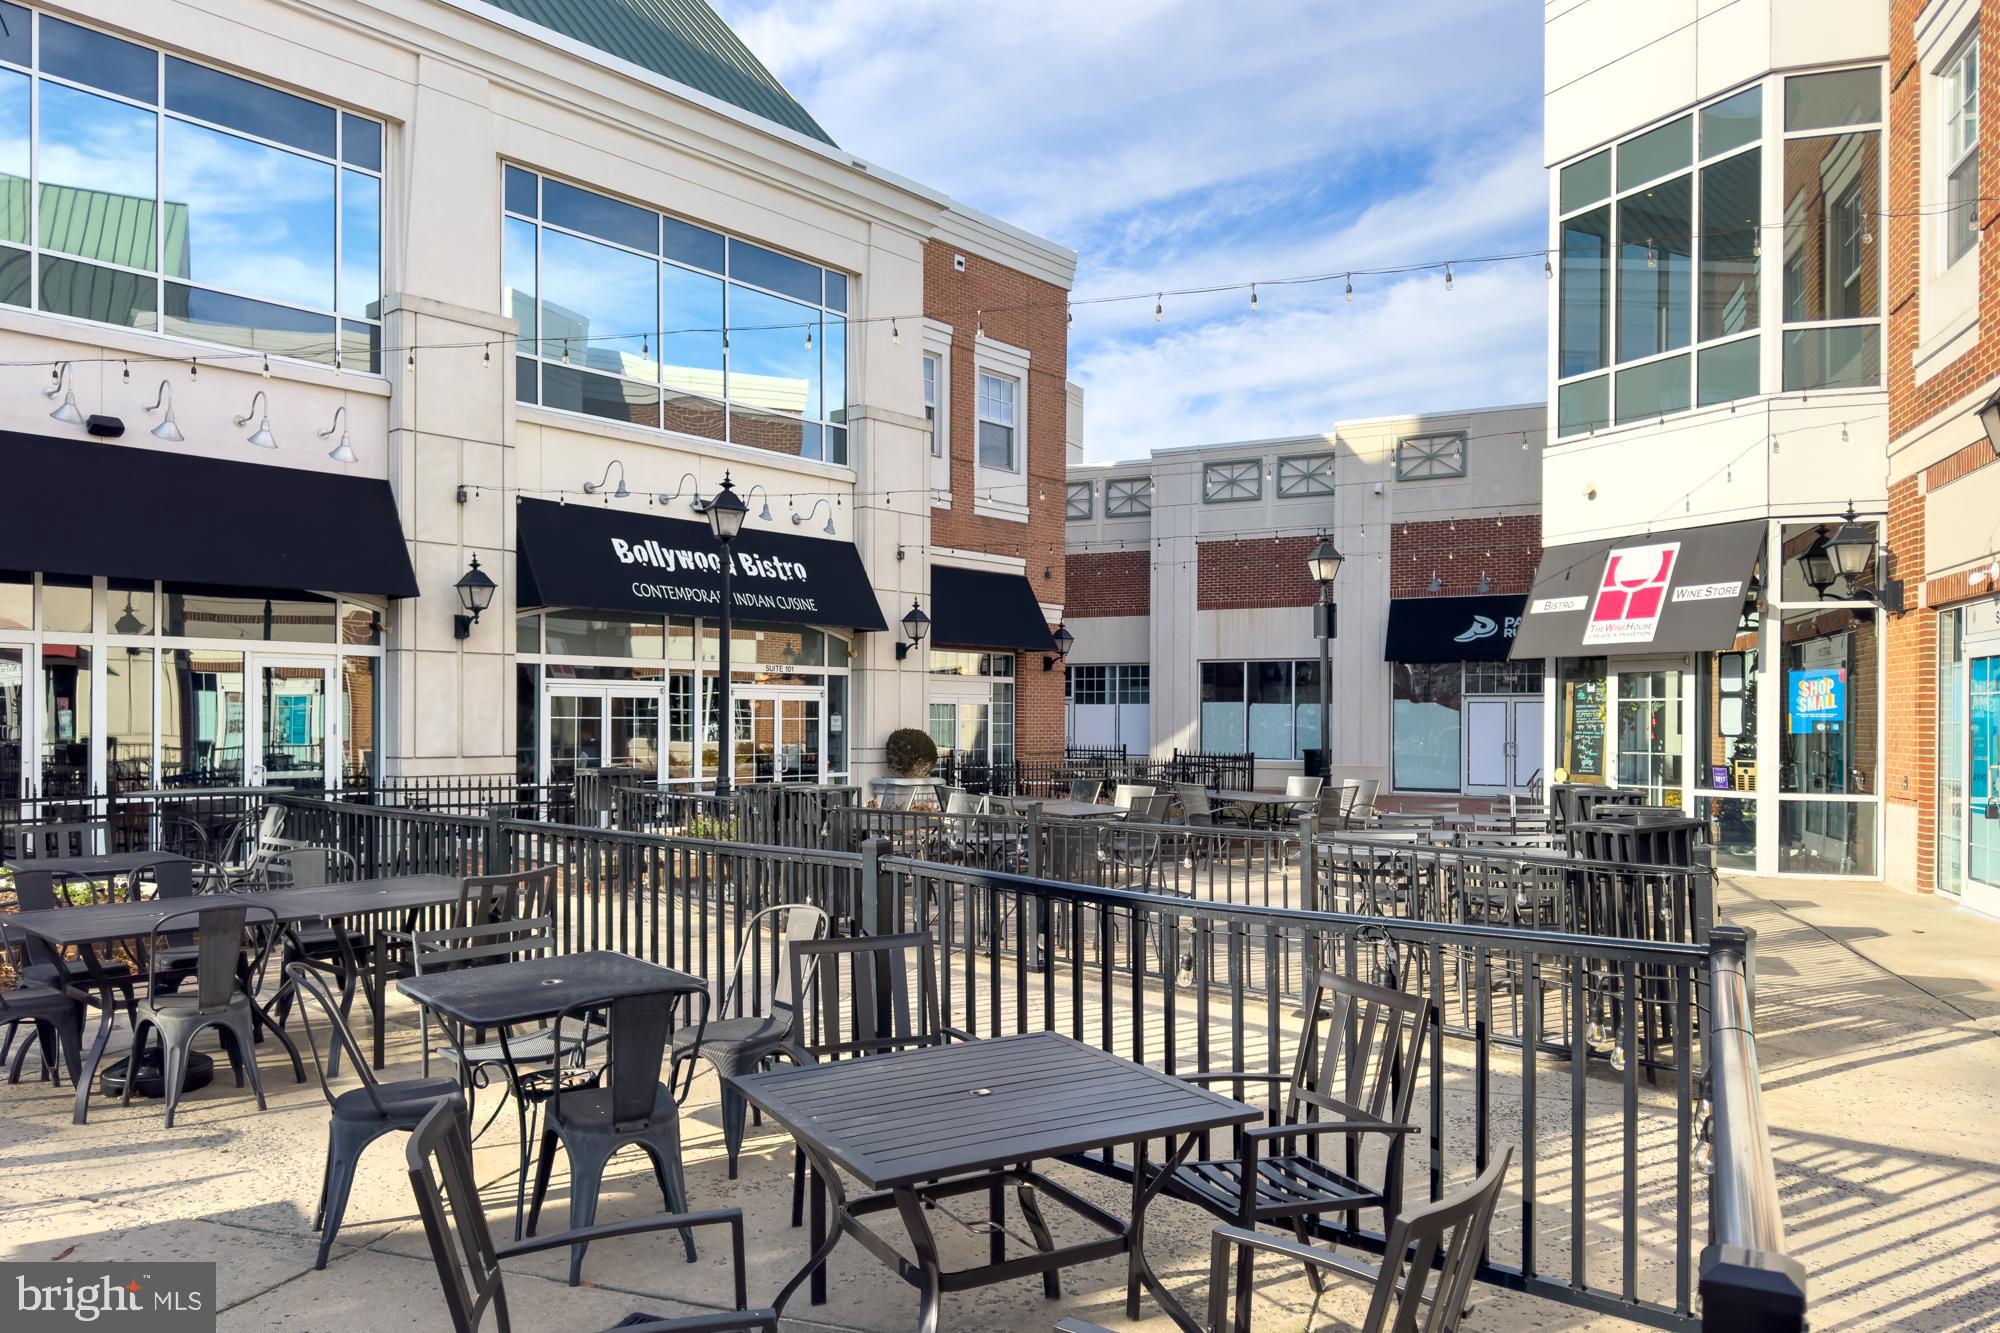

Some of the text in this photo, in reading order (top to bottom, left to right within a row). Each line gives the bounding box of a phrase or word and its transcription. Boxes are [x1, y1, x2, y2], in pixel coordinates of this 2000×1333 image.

[737, 552, 807, 582] Bistro
[632, 582, 818, 612] CONTEMPORA INDIAN CUISINE
[1677, 586, 1740, 600] WINE STORE
[766, 664, 795, 674] SUITE 101
[1797, 677, 1835, 697] SHOP
[1796, 693, 1838, 713] SMALL
